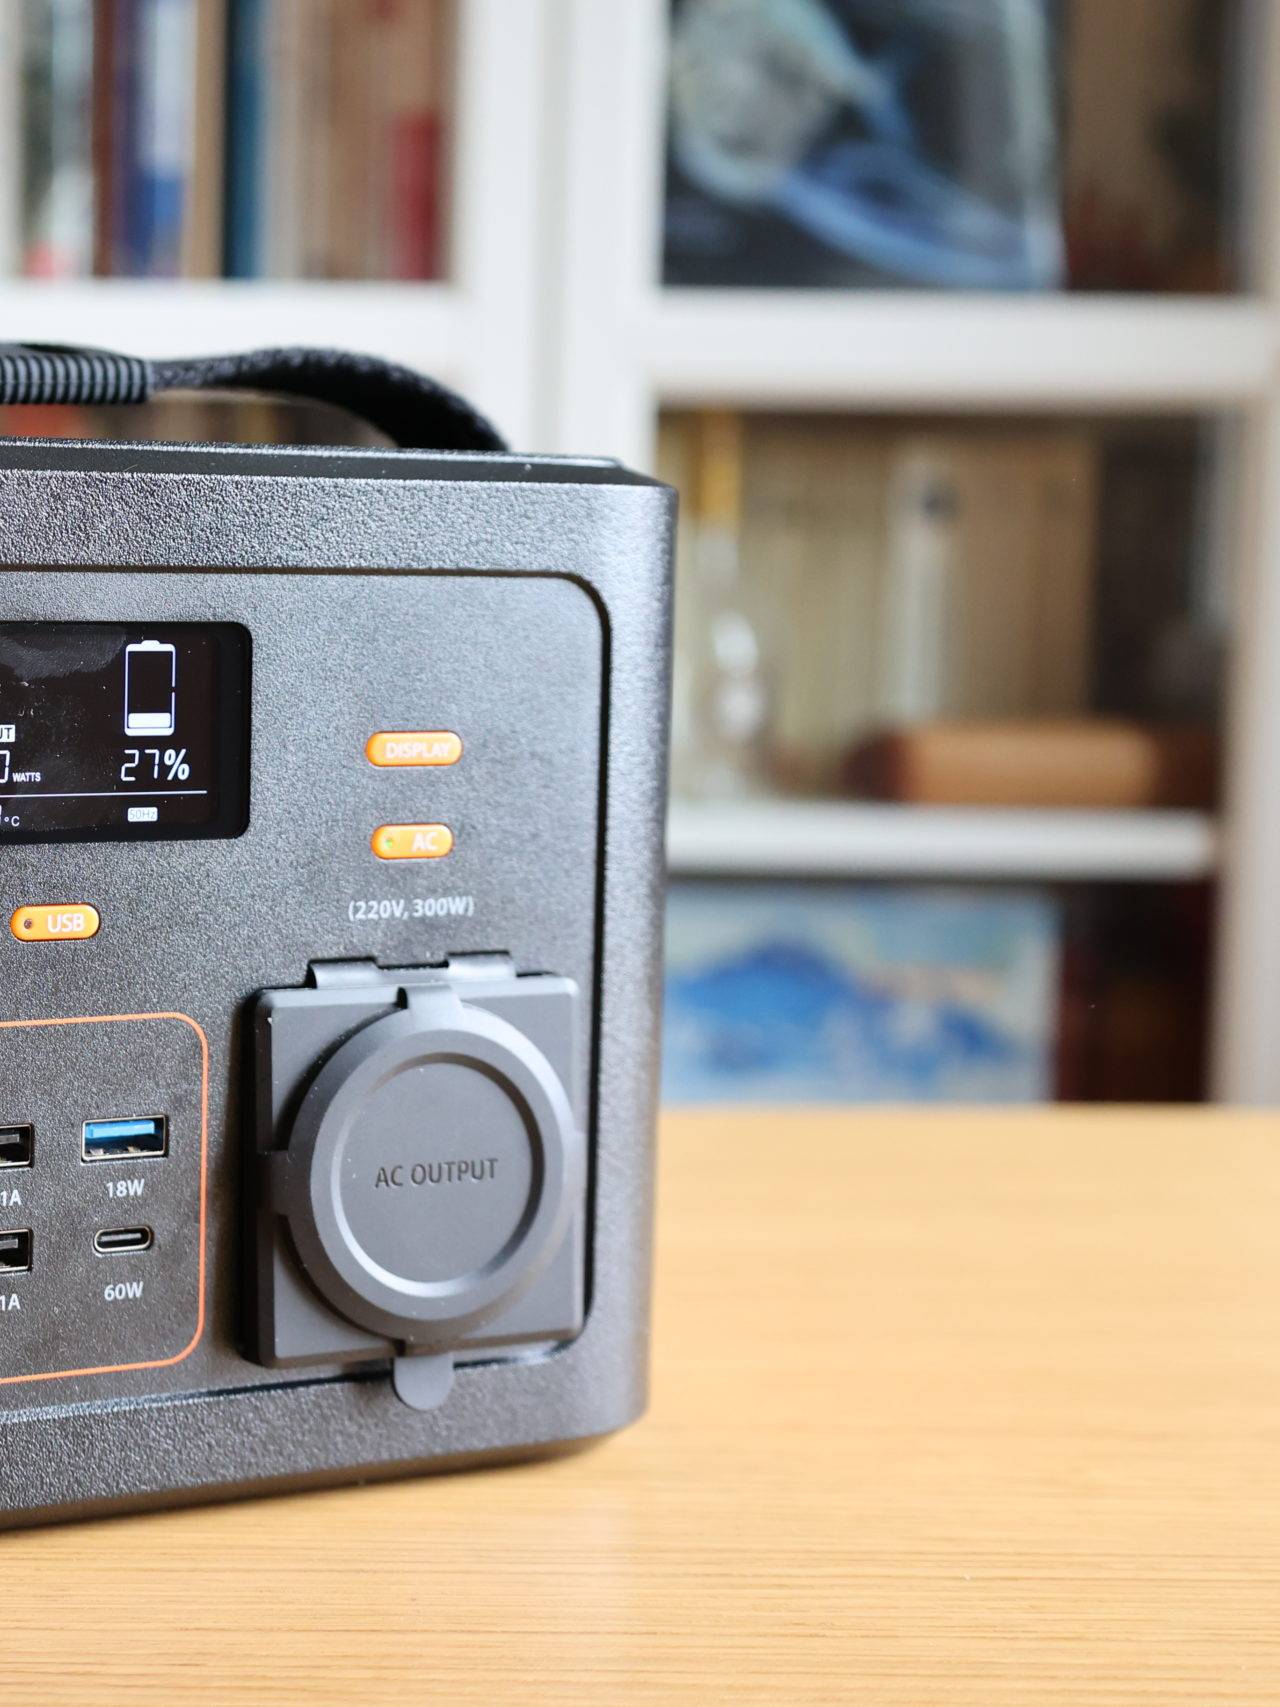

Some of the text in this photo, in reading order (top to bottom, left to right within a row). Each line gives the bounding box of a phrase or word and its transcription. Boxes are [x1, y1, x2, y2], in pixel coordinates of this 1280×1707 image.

[385, 742, 451, 759] DISPLAY
[121, 749, 189, 781] 27%
[12, 772, 41, 782] WATTS
[412, 832, 438, 851] AC
[348, 896, 475, 921] (220V, 300W)
[47, 914, 85, 933] USB
[374, 1158, 499, 1188] AC OUTPUT
[106, 1178, 145, 1198] 18W
[104, 1281, 144, 1301] 60W
